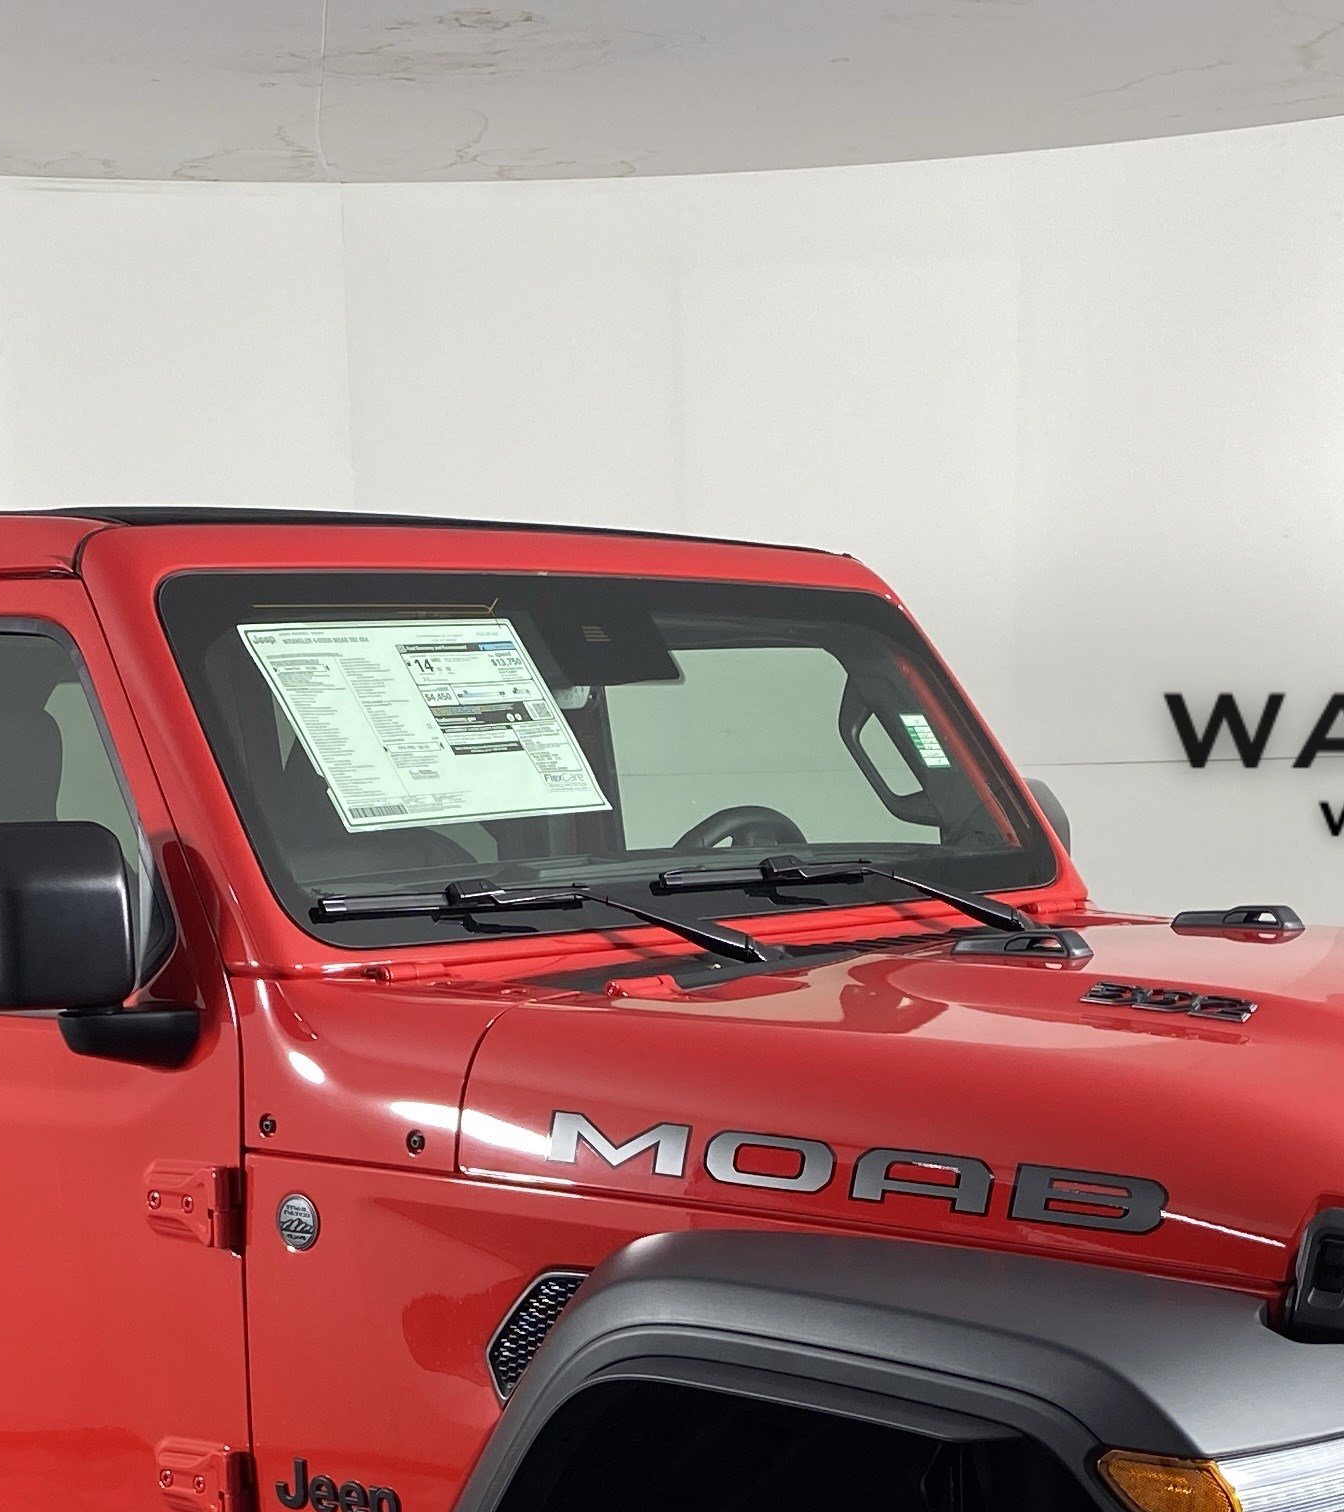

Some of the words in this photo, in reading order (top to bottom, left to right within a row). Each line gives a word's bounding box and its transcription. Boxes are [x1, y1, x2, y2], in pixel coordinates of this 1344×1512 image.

[414, 659, 435, 673] 14
[490, 657, 523, 667] $13,750
[544, 774, 584, 782] FlexCare
[545, 1109, 1169, 1237] MOAB
